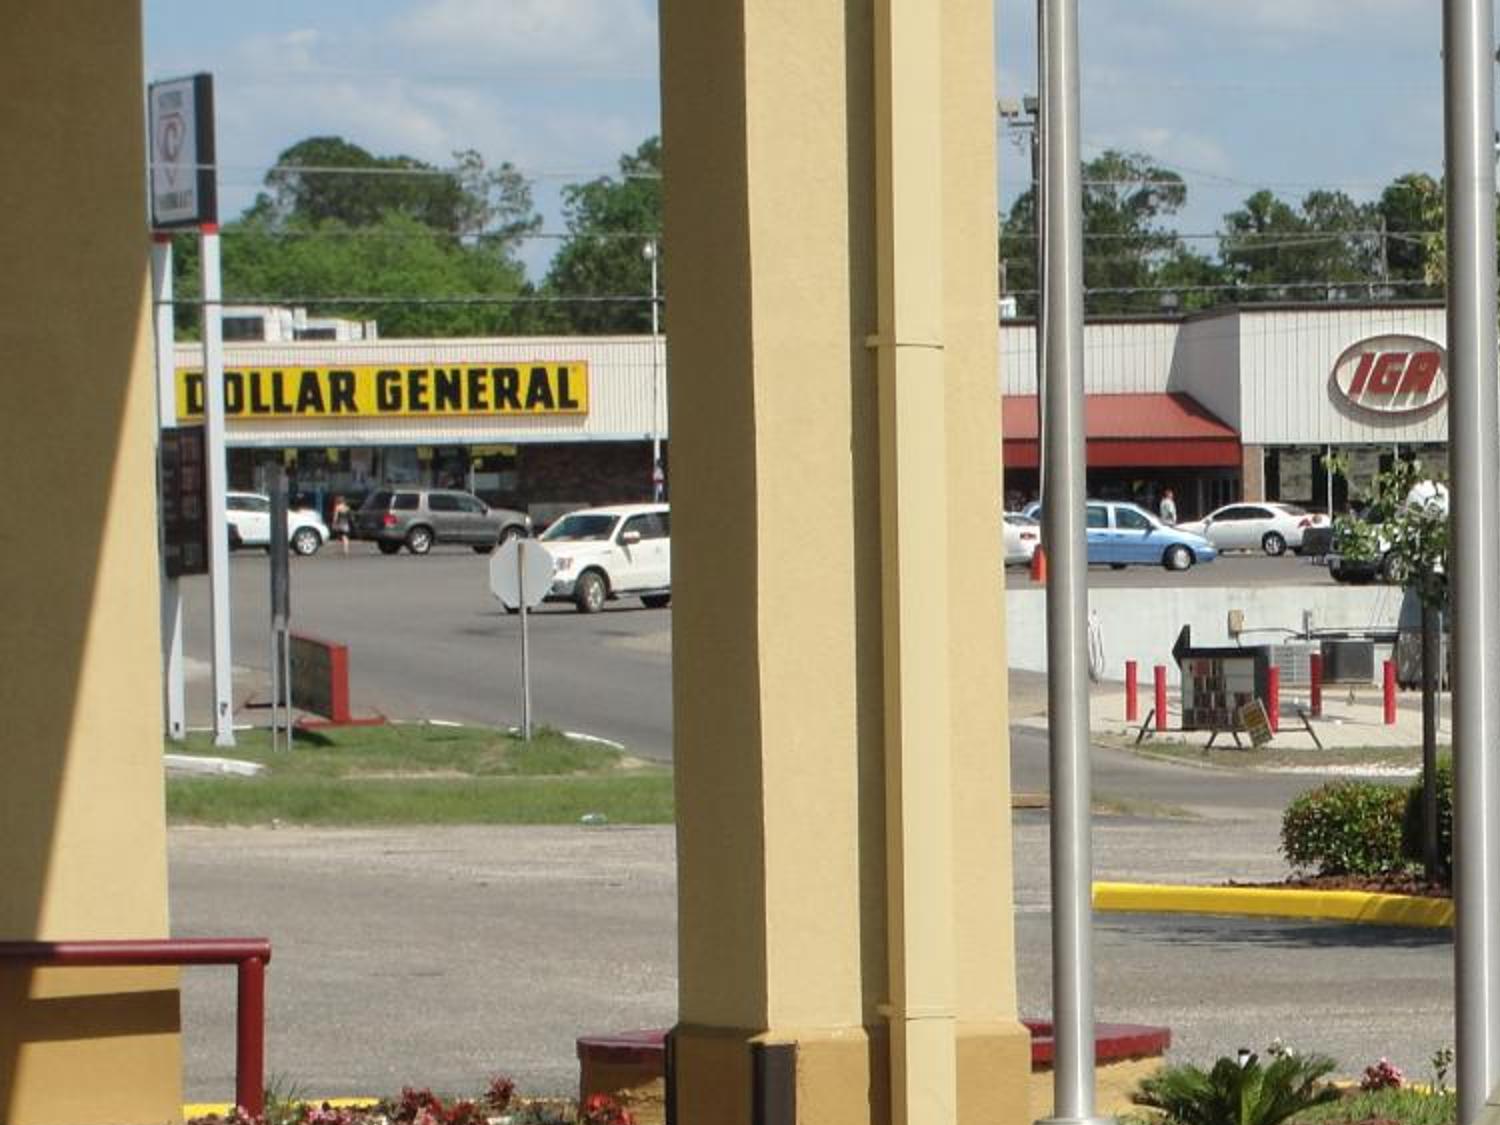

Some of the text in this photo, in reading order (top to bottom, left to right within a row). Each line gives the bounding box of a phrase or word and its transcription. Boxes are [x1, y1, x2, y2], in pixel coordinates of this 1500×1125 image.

[184, 367, 580, 414] DOLLAR GENERAL
[1347, 352, 1441, 405] IGA
